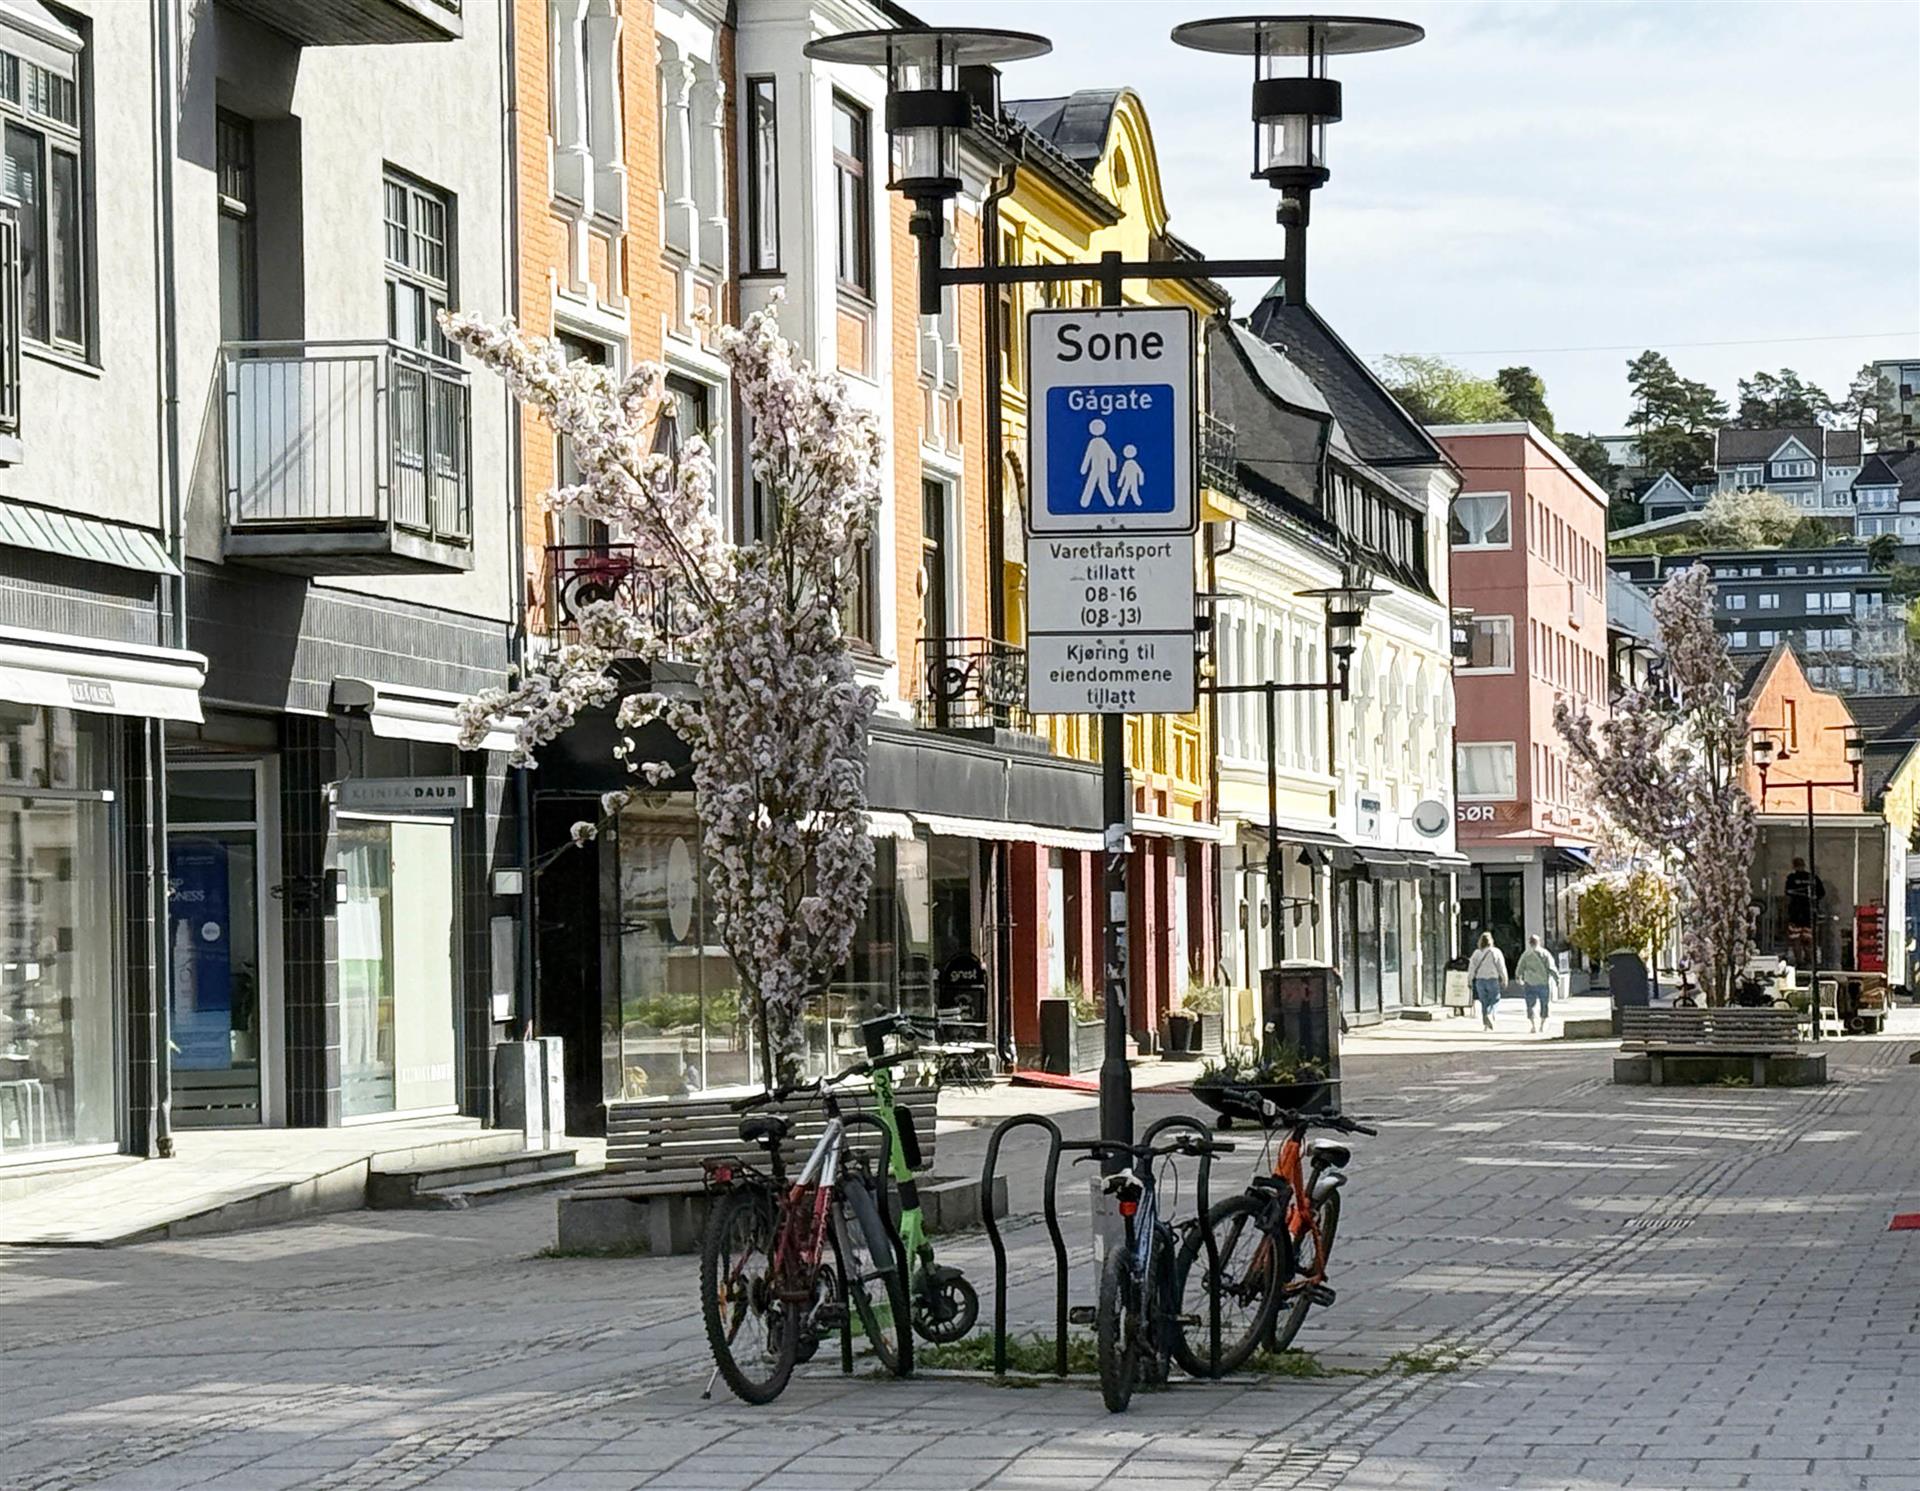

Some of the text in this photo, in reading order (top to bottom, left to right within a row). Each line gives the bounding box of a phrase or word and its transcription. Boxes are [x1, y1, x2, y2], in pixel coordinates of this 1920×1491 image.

[1056, 323, 1164, 362] Sone
[1068, 388, 1153, 415] Gågate
[1050, 542, 1172, 562] Varetransport
[1086, 565, 1136, 581] tillatt
[1085, 587, 1137, 603] 08-16
[1080, 607, 1142, 626] (08-13)
[1067, 643, 1155, 665] Kjøring til
[1049, 667, 1172, 682] eiendommene
[1086, 687, 1136, 704] tillatt
